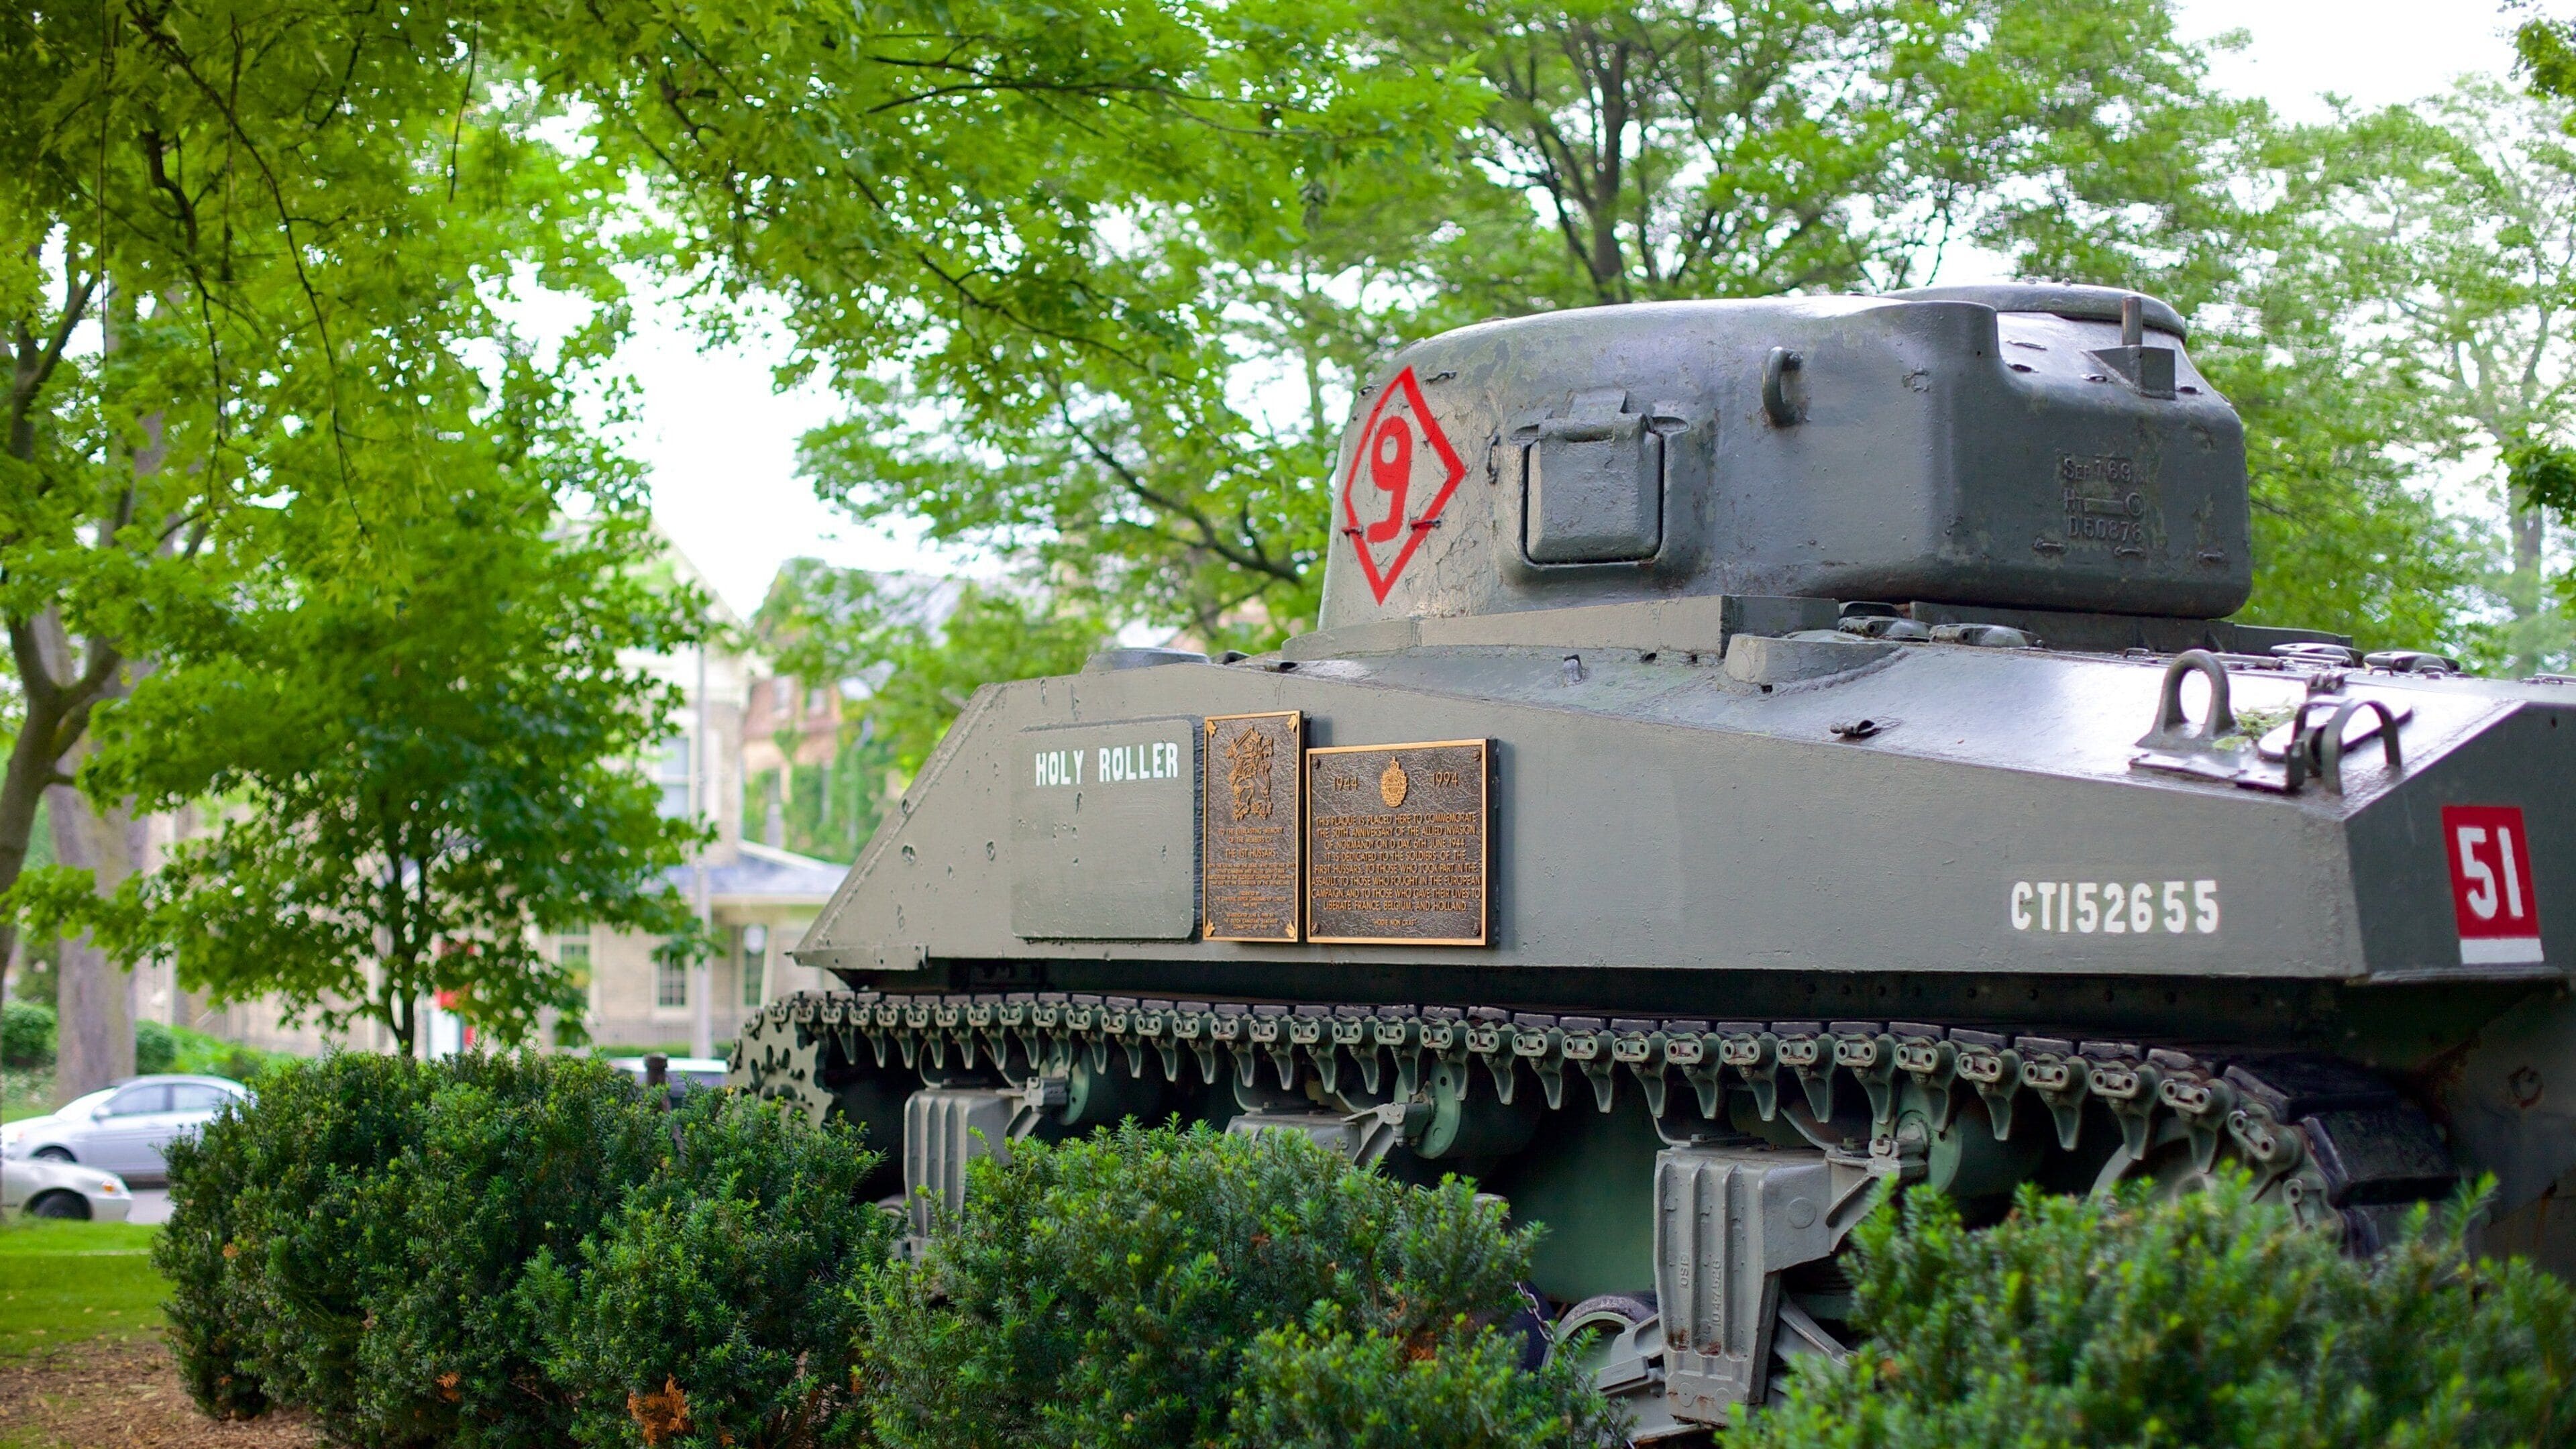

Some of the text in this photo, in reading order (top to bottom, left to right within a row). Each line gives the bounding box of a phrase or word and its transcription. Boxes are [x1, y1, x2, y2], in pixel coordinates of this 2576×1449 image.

[1366, 415, 1413, 543] 9
[1035, 742, 1179, 786] HOLY ROLLER
[1334, 776, 1358, 791] 1944
[1432, 771, 1459, 788] 1994
[1316, 812, 1476, 826] THIS PLAQUE IS PLACED HERE TO COMMEMORATE
[1317, 824, 1475, 838] THE 50TH ANNIVERSARY OF THE ALLIED INVASION
[1324, 840, 1334, 850] OF
[1336, 840, 1375, 849] NORMANDY
[1377, 839, 1388, 849] ON
[1391, 839, 1396, 849] D
[1413, 839, 1427, 848] 6TH
[1430, 838, 1446, 848] JUNE
[1226, 849, 1236, 858] THE
[1238, 849, 1248, 857] 1ST
[1325, 850, 1466, 862] IT IS DEDICATED TO THE SOLDIERS OF THE
[1315, 864, 1331, 874] FIRST
[1366, 863, 1375, 873] TO
[1377, 863, 1397, 873] THOSE
[1400, 863, 1417, 873] WHO
[1419, 863, 1439, 873] TOOK
[1440, 863, 1454, 873] PART
[1466, 863, 1479, 872] THE
[2457, 826, 2524, 920] 51
[1340, 876, 1349, 886] TO
[1351, 875, 1371, 885] THOSE
[1373, 875, 1389, 885] WHO
[1391, 875, 1417, 885] FOUGHT
[1419, 875, 1428, 885] IN
[1430, 875, 1442, 885] THE
[1444, 875, 1481, 885] EUROPEAN
[1347, 888, 1359, 898] AND
[1362, 888, 1371, 898] TO
[1373, 888, 1393, 898] THOSE
[1395, 888, 1411, 898] WHO
[1413, 888, 1430, 898] GAVE
[1432, 888, 1450, 898] THEIR
[1452, 888, 1469, 898] LIVES
[1472, 888, 1481, 898] TO
[1324, 900, 1351, 910] LIBERATE
[1416, 900, 1430, 910] AND
[2011, 880, 2219, 933] CT152655
